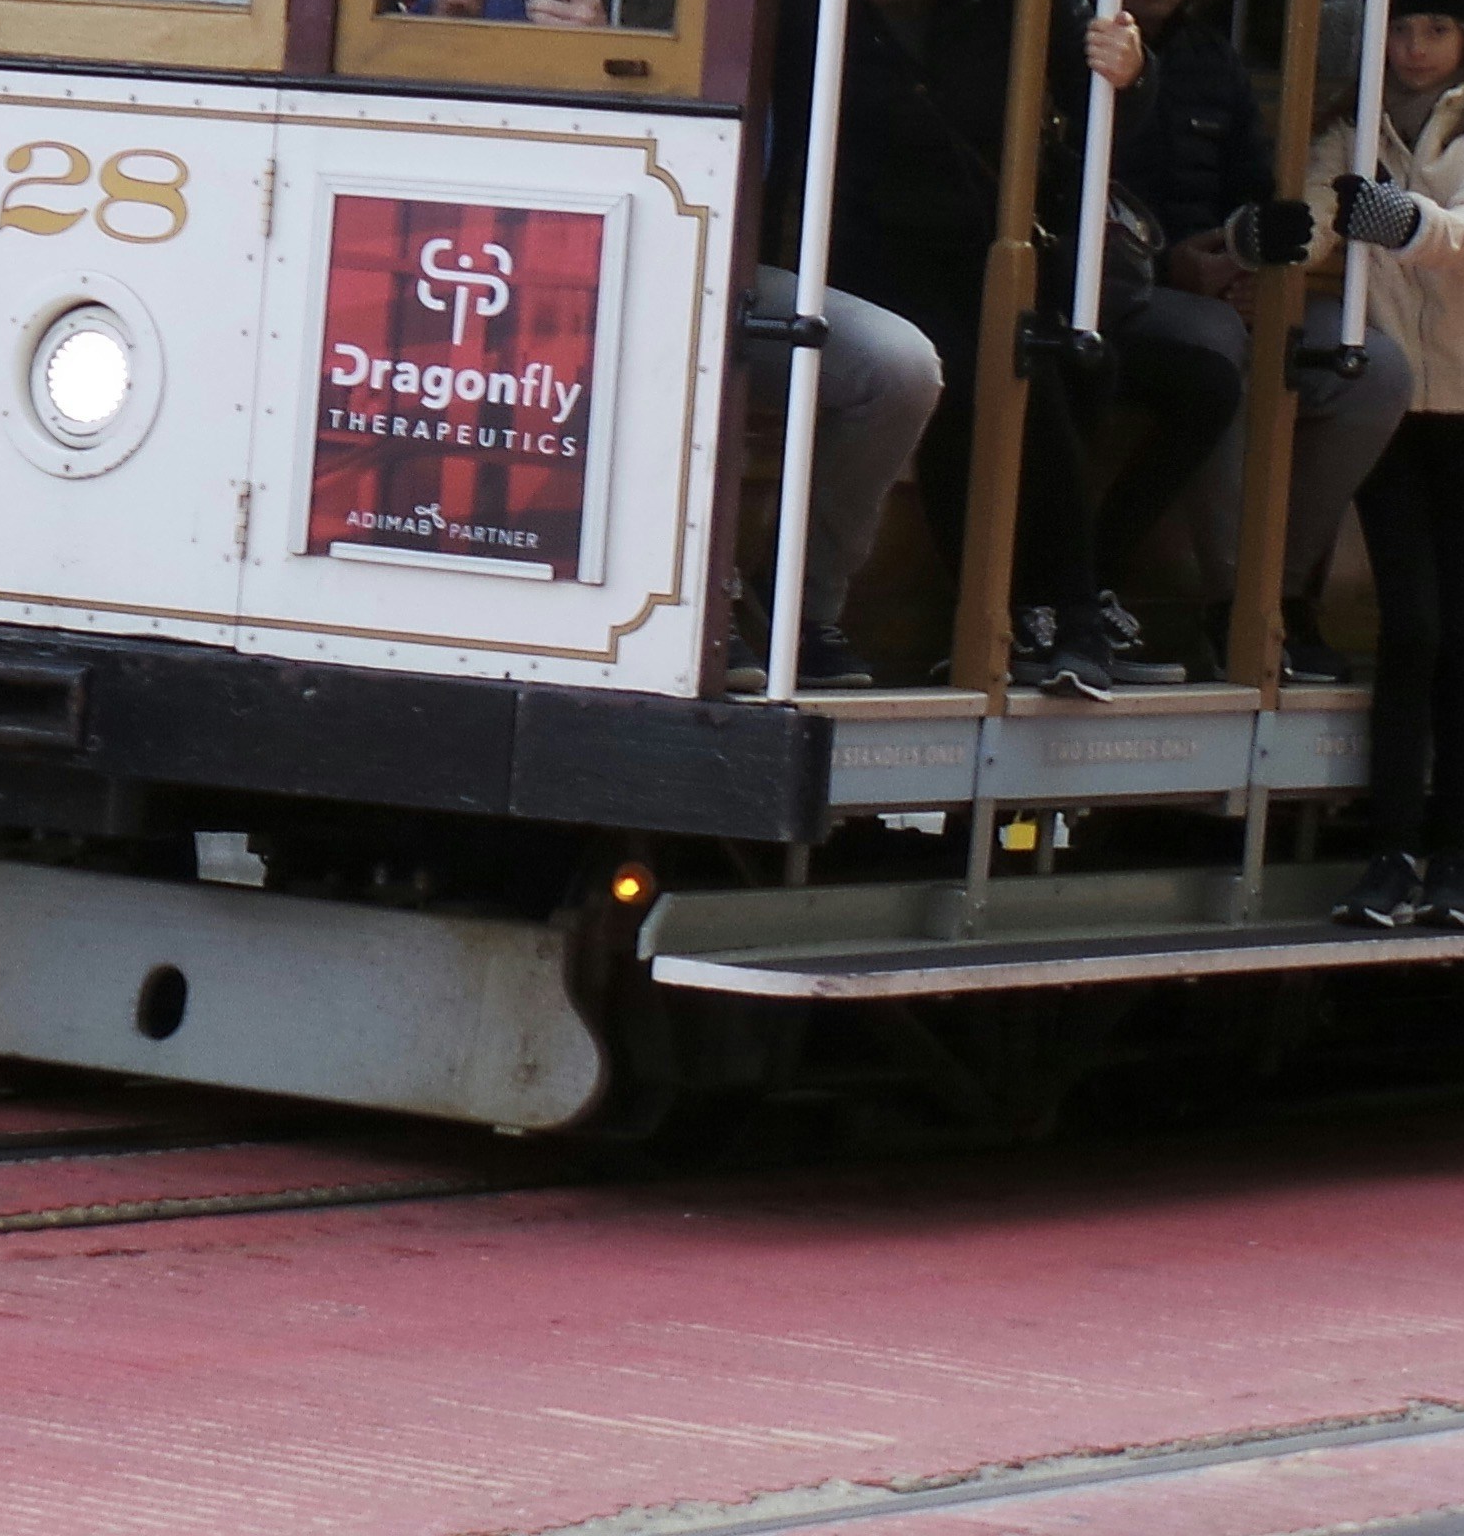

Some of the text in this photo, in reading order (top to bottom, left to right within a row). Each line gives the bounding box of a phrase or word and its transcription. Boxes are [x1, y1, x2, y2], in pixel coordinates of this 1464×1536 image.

[331, 341, 583, 424] Dragonfly
[328, 407, 579, 458] THERAPEUTICS
[345, 509, 539, 550] ADIMAB PARTNER
